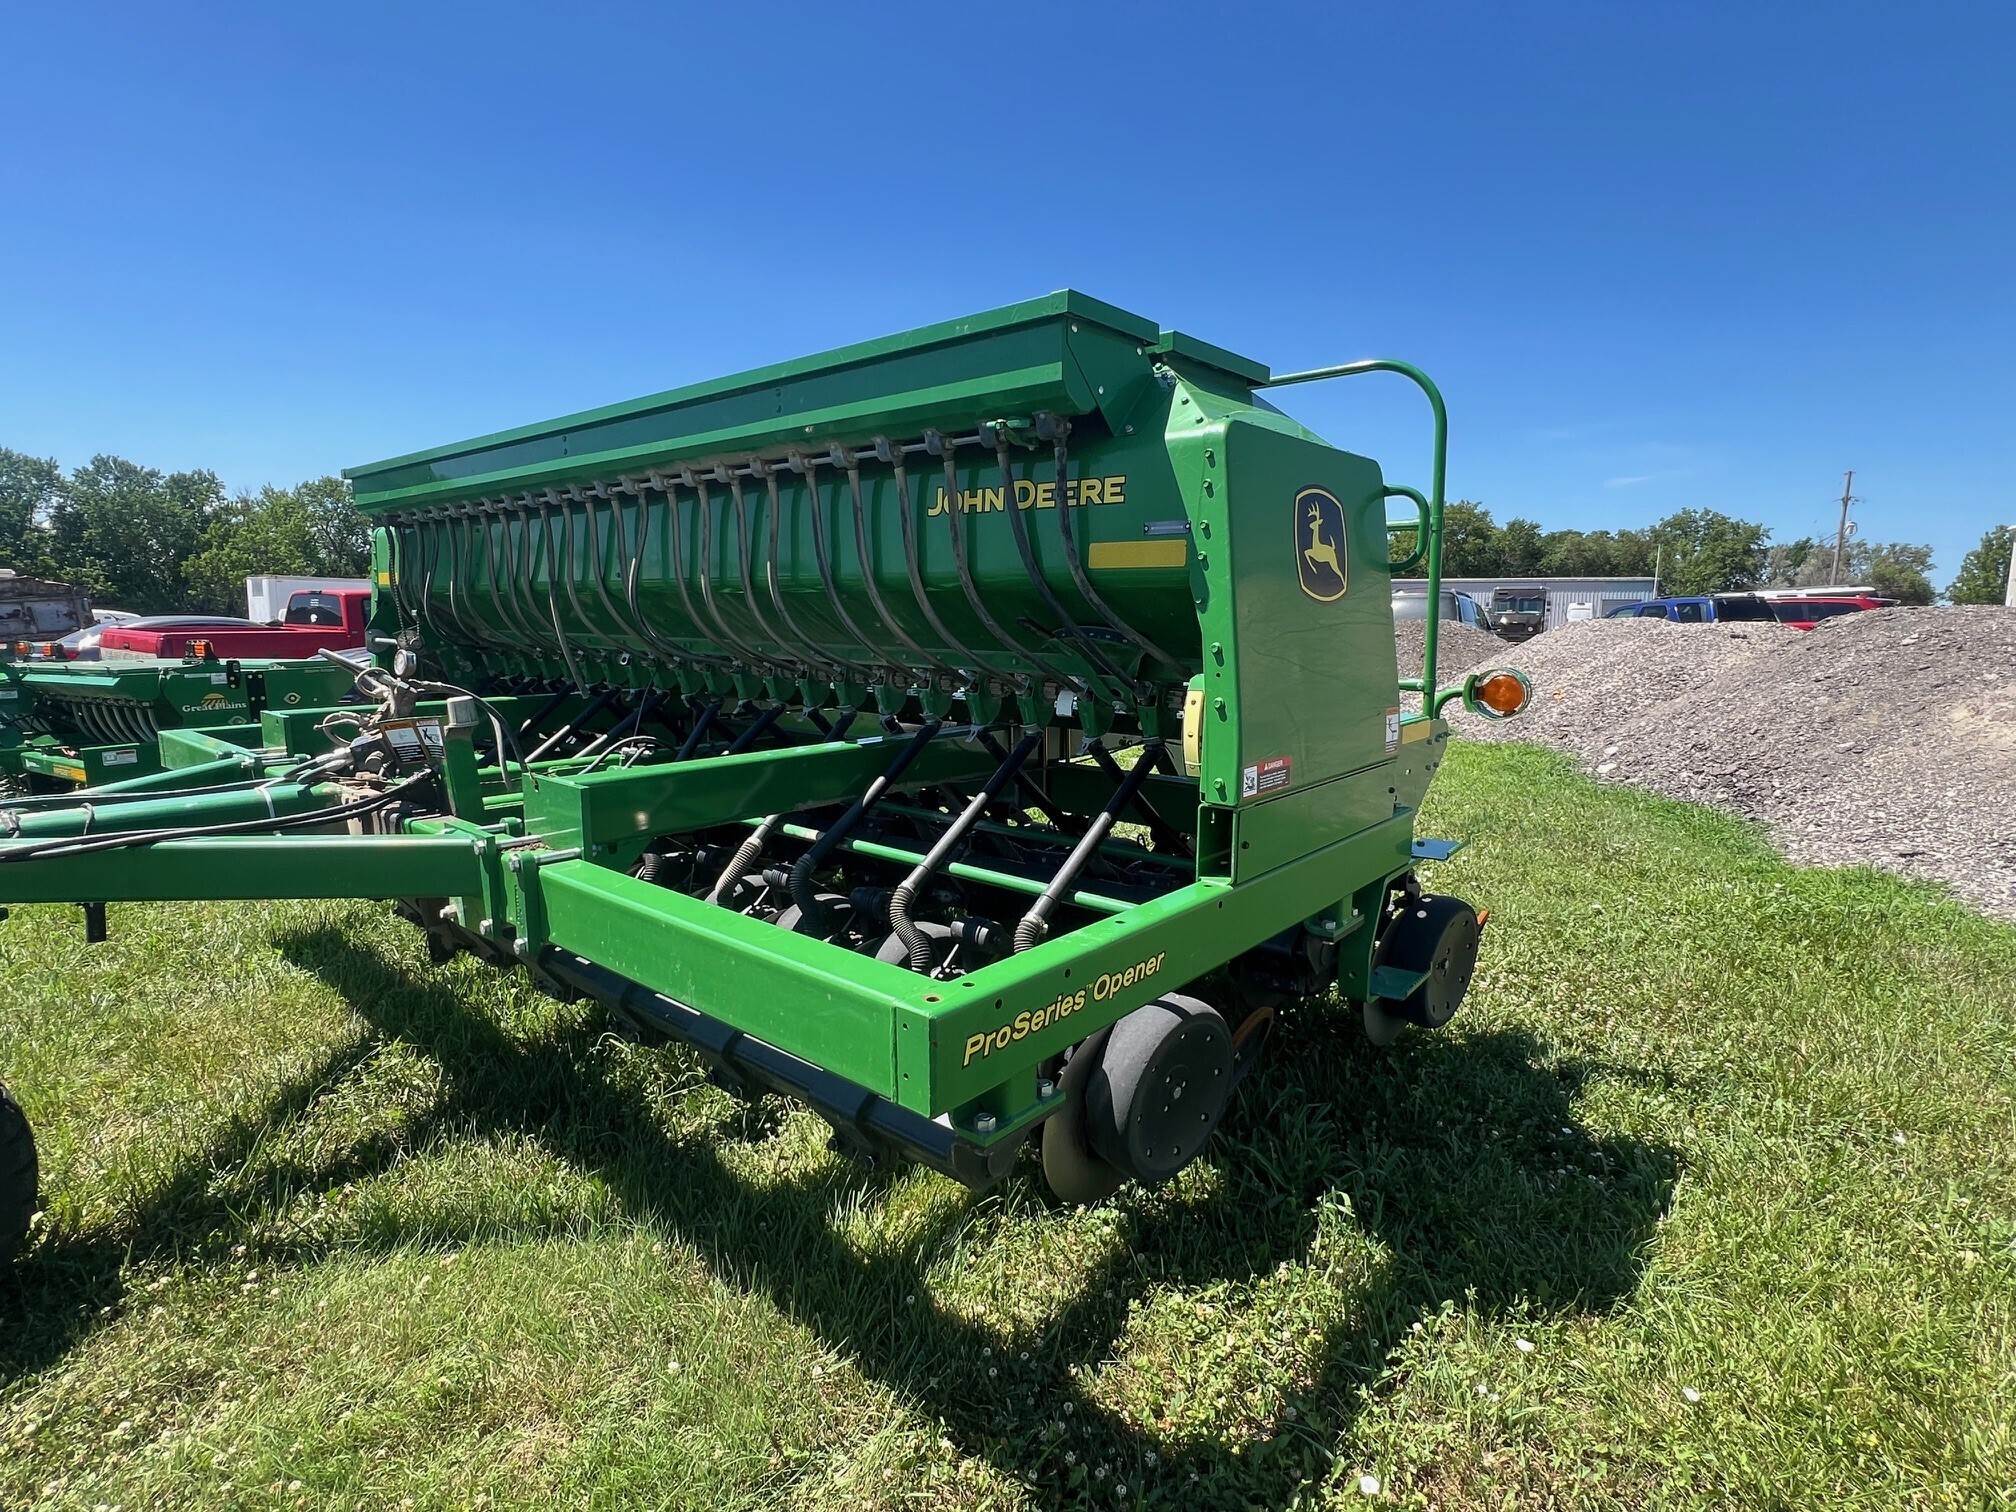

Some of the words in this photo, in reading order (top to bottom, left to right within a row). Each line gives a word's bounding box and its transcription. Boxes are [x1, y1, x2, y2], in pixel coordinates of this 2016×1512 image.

[927, 486, 1006, 517] JOHN
[1013, 475, 1127, 511] DEERE
[182, 704, 213, 712] Great
[215, 702, 247, 710] Plains
[1093, 950, 1166, 1002] Opener
